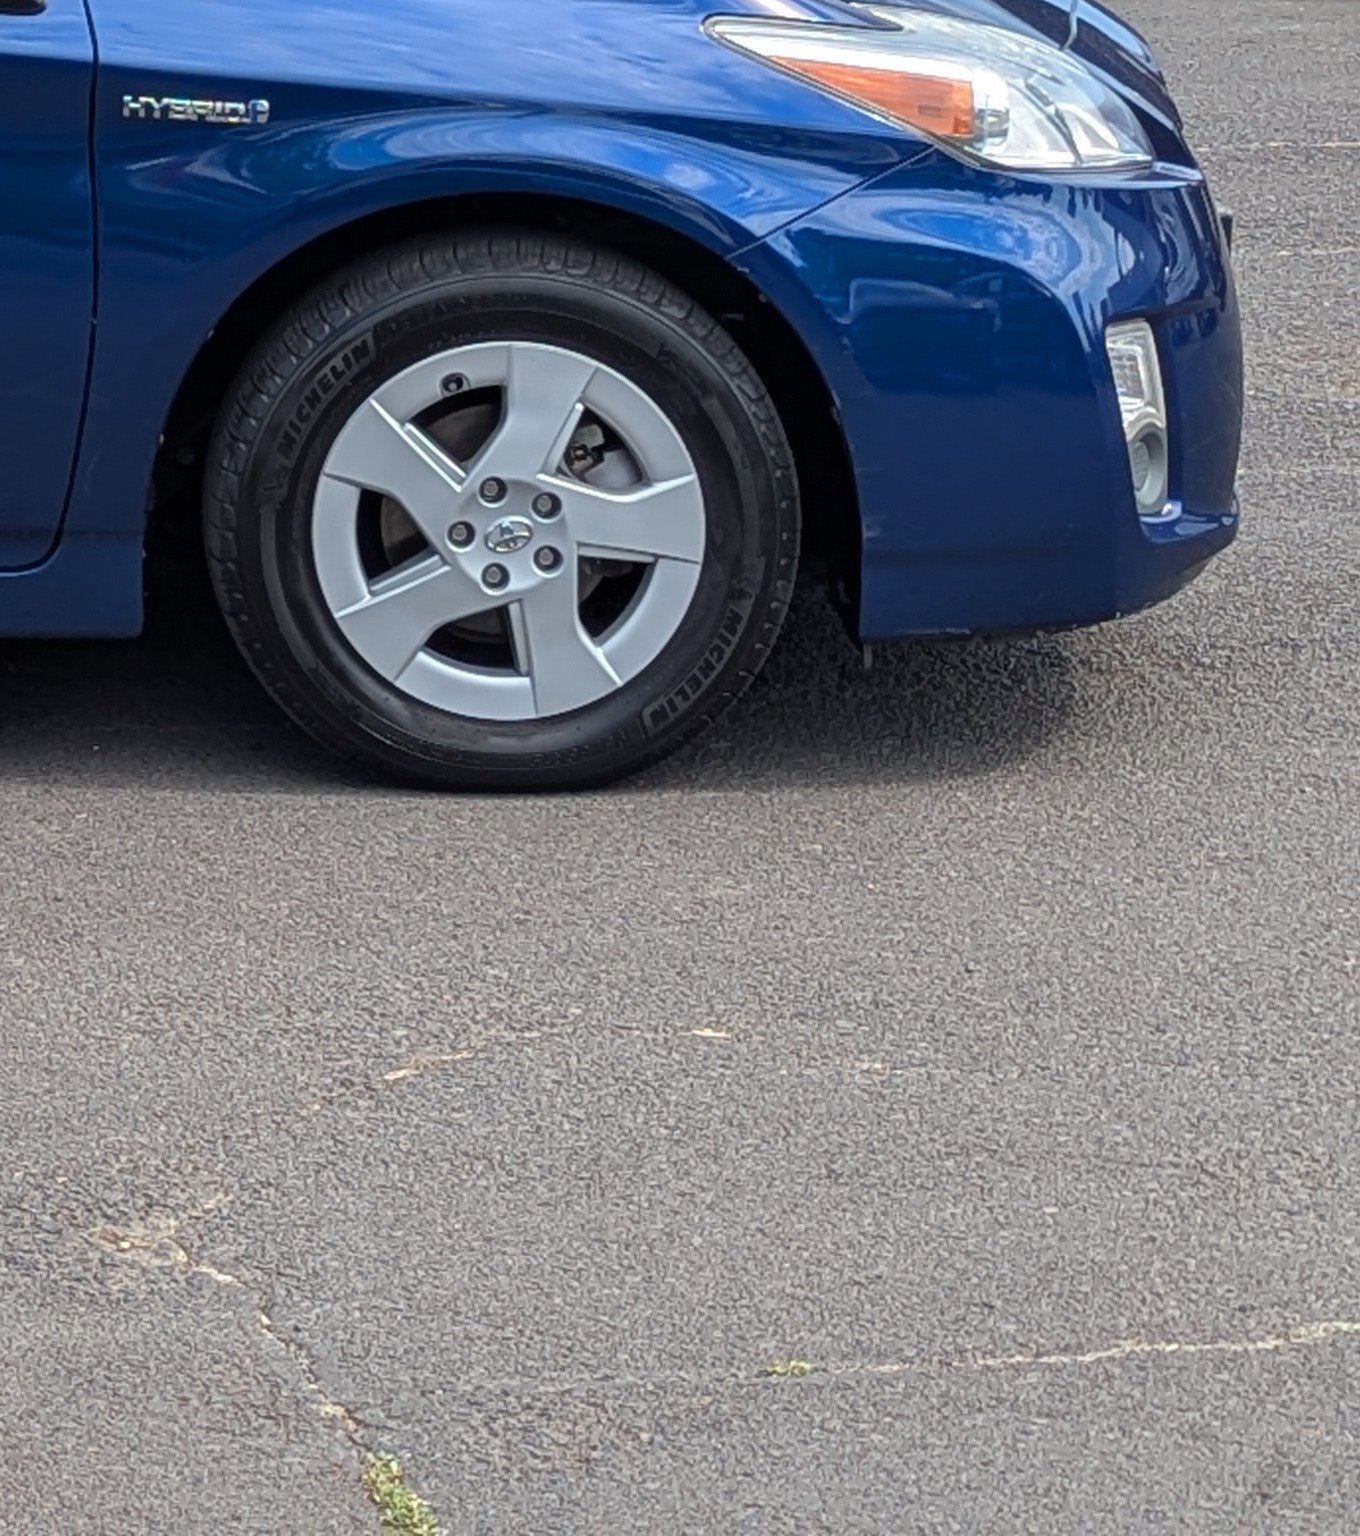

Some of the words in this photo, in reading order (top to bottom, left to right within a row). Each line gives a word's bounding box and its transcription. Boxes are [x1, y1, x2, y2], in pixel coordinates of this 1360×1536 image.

[122, 94, 246, 124] HYBRID
[276, 338, 372, 460] MICHELIN
[648, 607, 744, 727] MICHELIN
